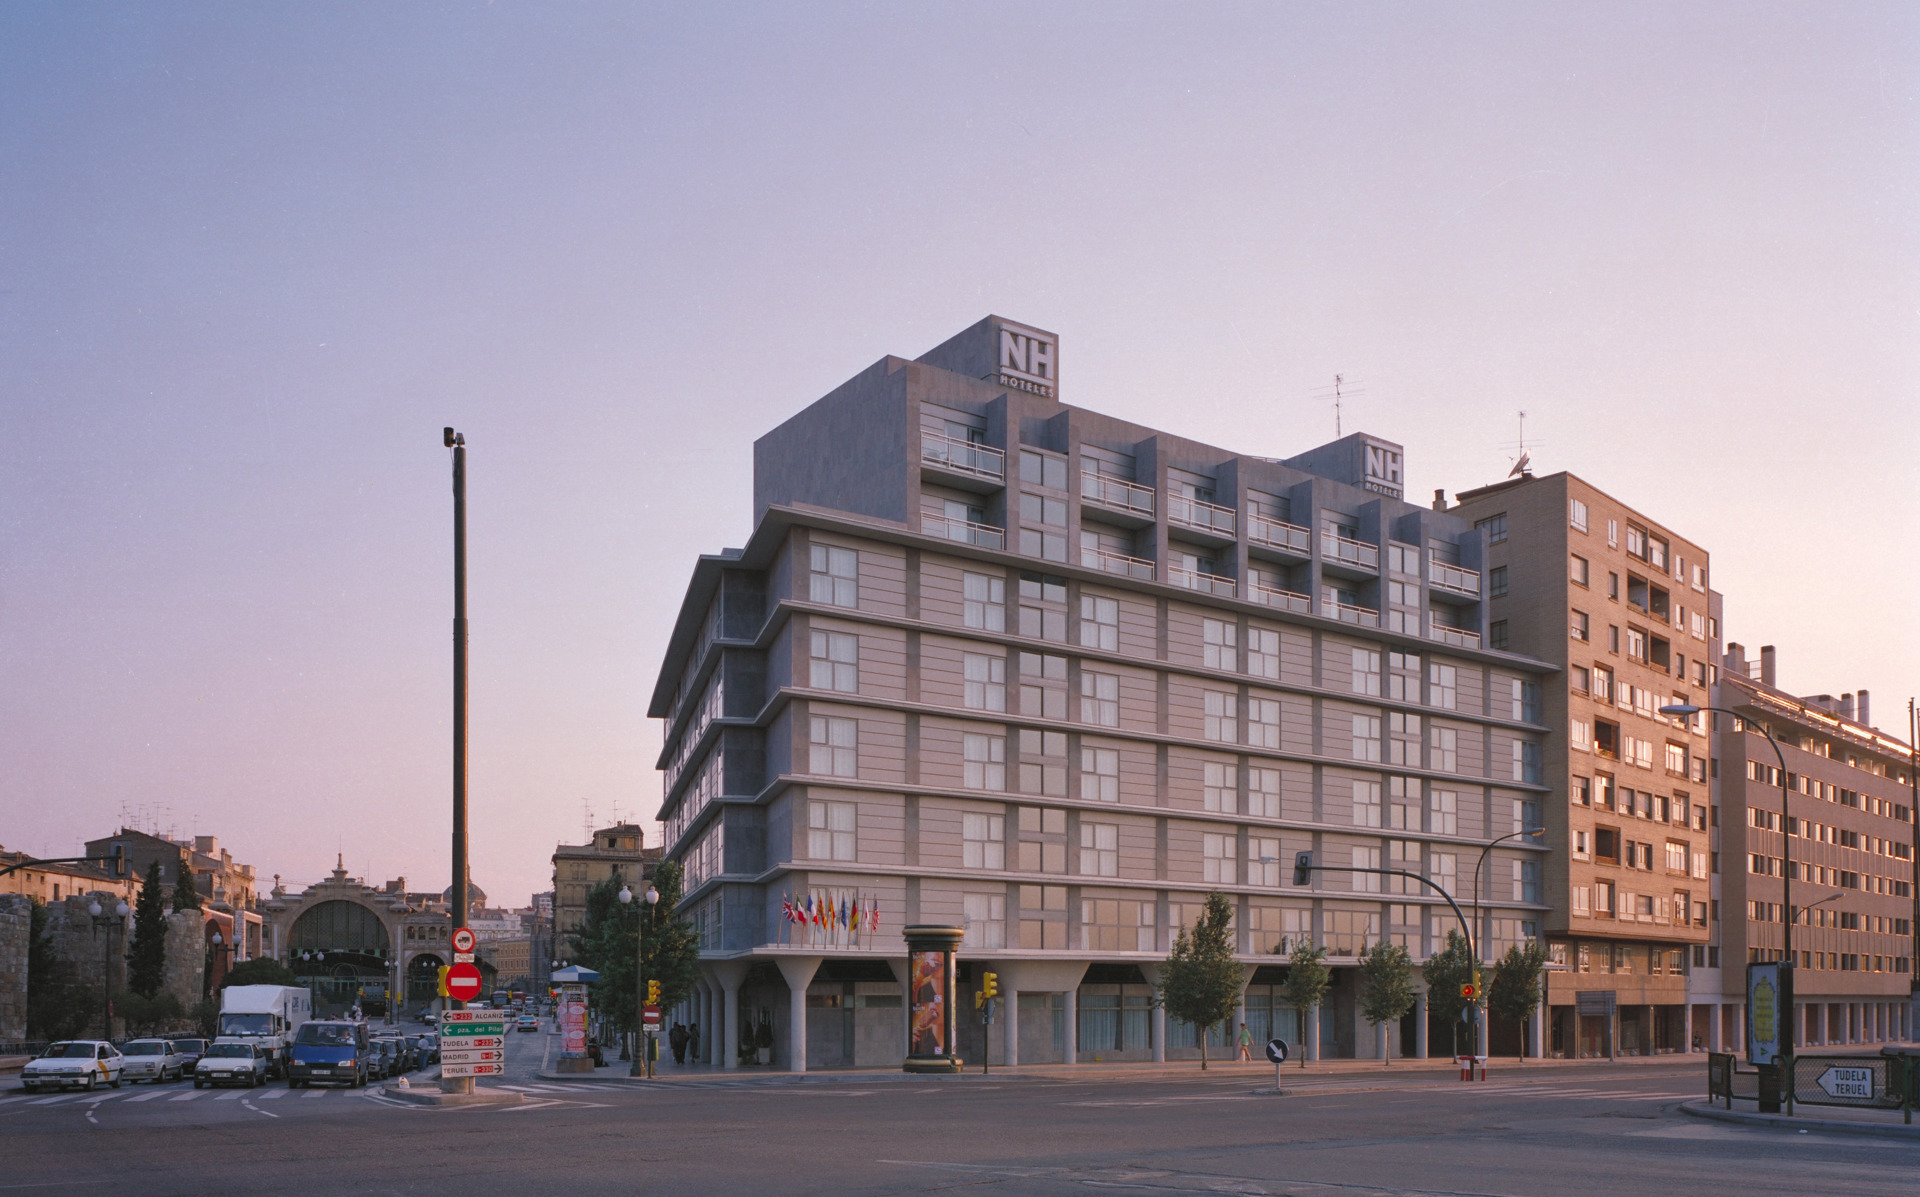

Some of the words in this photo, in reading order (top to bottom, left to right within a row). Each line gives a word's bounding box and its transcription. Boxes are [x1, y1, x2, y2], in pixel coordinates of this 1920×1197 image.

[1001, 330, 1054, 379] NH
[1001, 375, 1053, 397] HOTELES
[1365, 445, 1403, 484] NH
[1835, 1070, 1867, 1081] TUDELA
[1835, 1084, 1867, 1096] TERUEL
